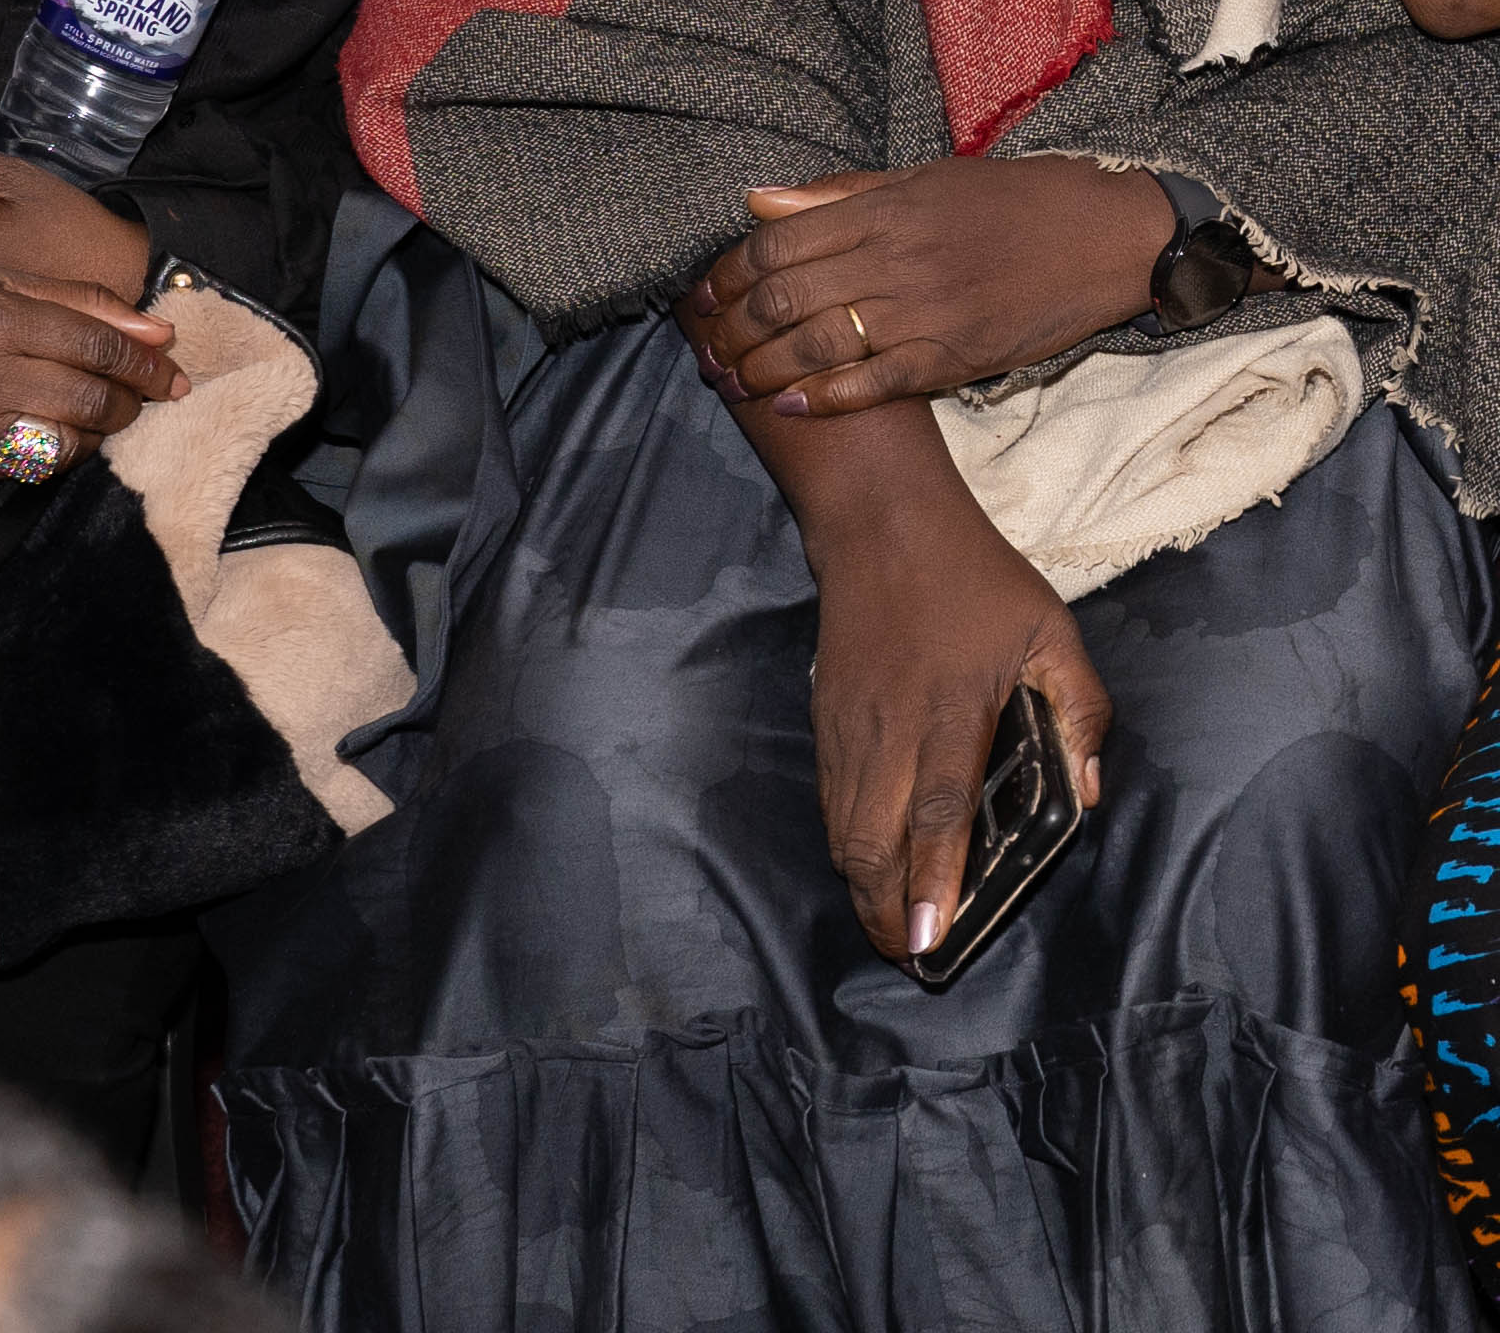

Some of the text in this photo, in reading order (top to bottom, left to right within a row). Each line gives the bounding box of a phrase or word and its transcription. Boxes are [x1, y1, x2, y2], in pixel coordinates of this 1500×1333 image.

[63, 23, 85, 39] STILL
[86, 33, 134, 60] SPRING
[133, 56, 160, 69] WATER
